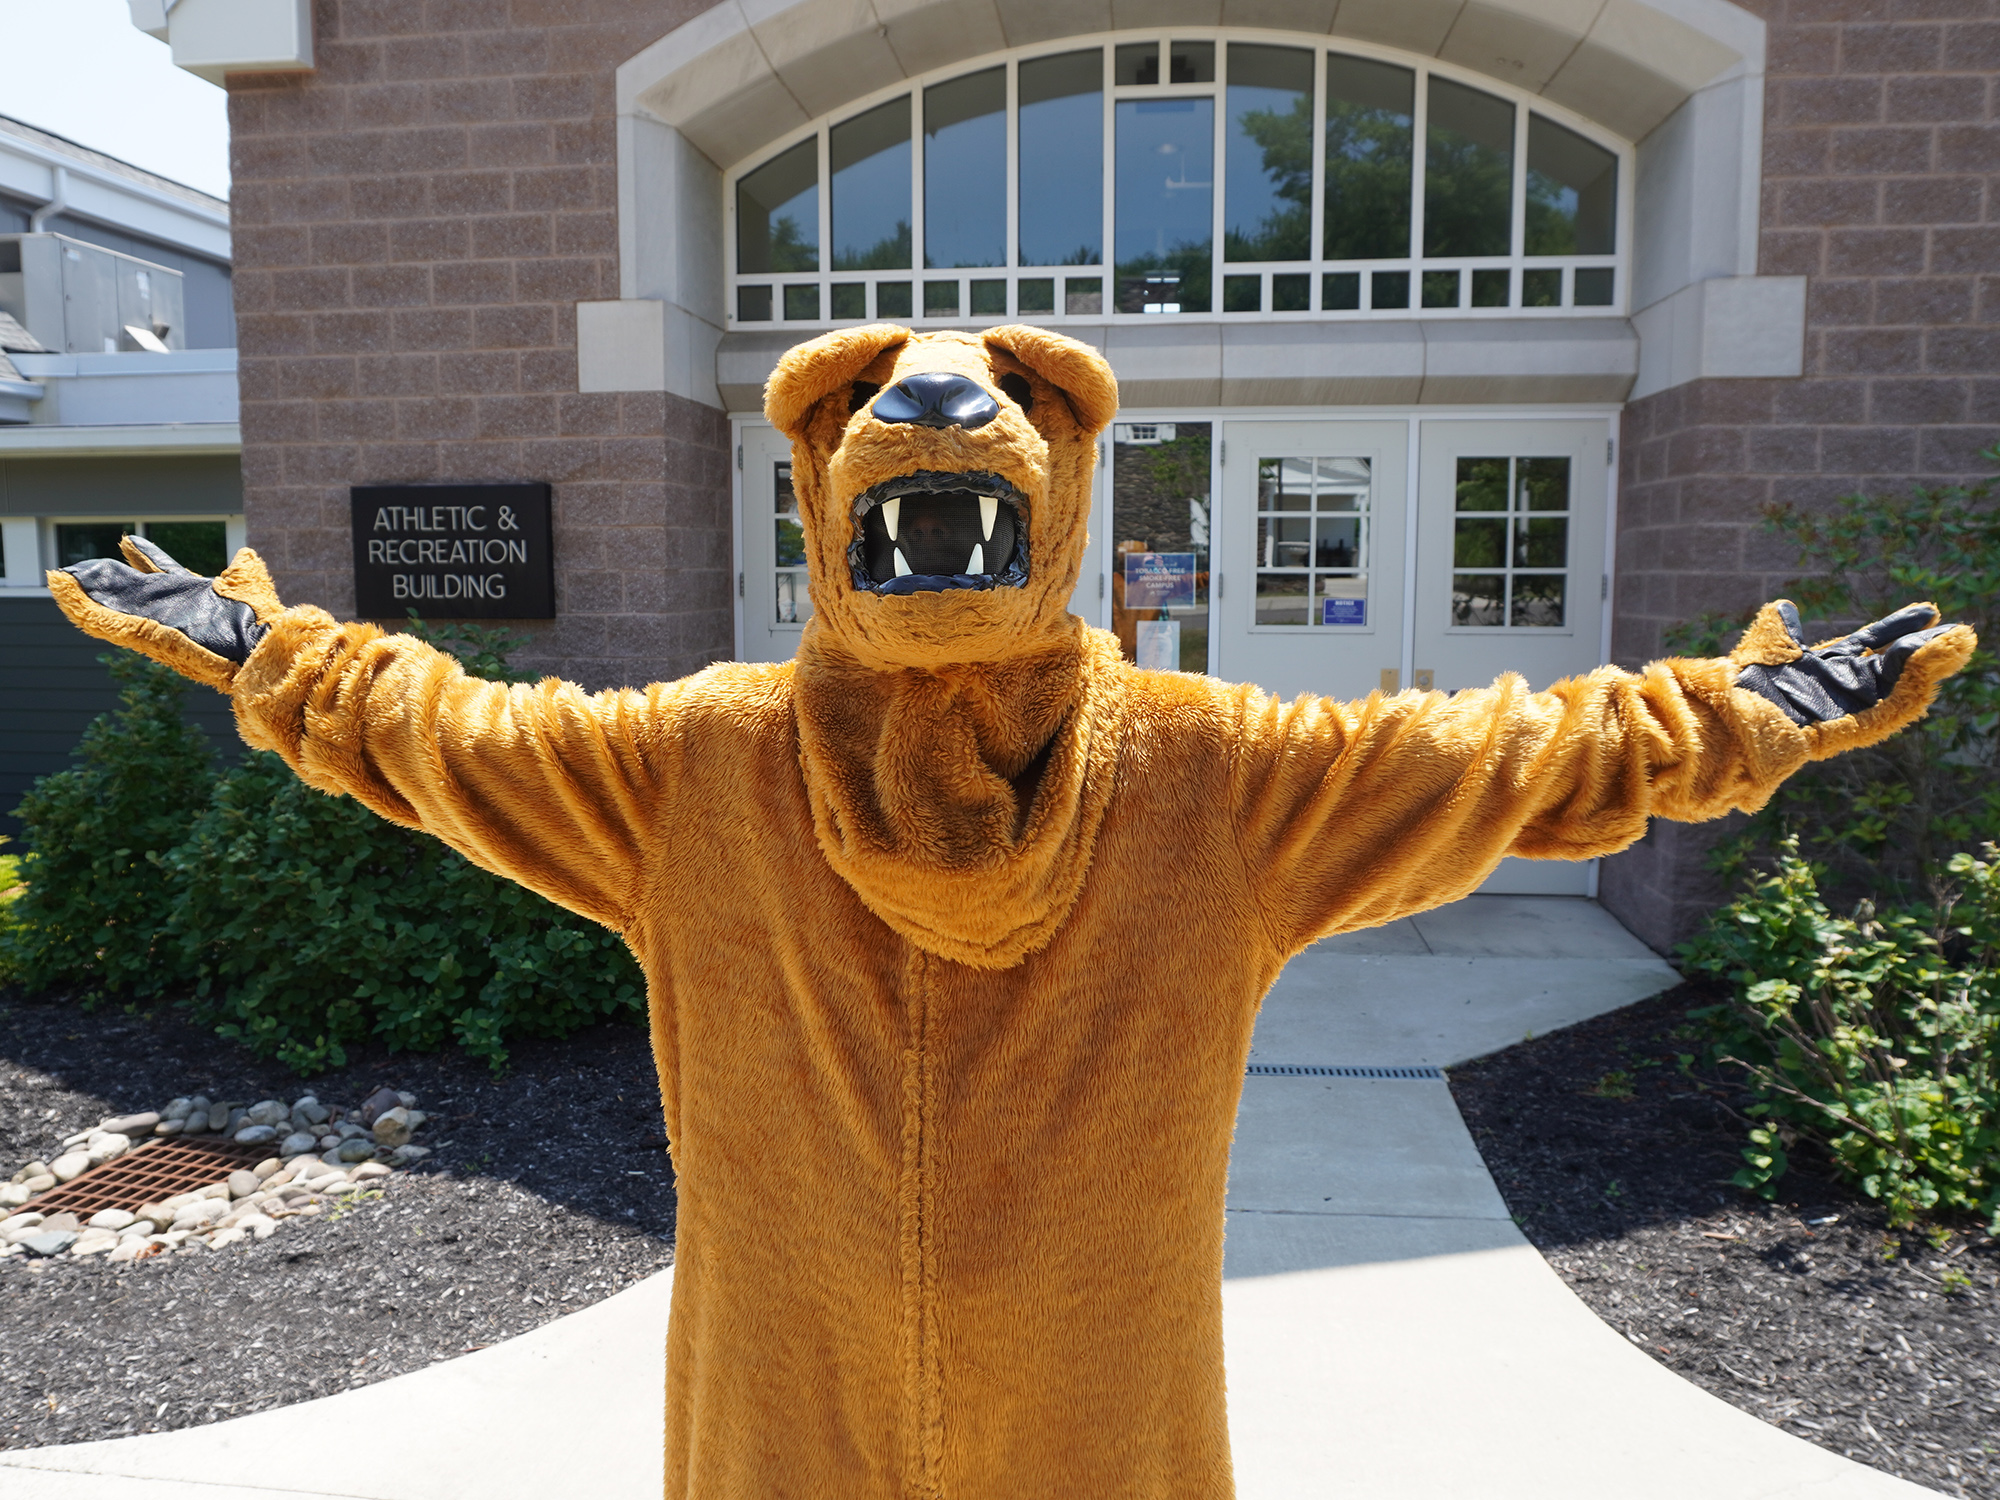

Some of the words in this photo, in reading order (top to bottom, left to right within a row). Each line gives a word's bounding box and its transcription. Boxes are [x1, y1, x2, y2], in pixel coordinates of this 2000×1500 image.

[373, 505, 487, 531] ATHLETIC
[497, 505, 520, 531] &
[368, 538, 528, 564] RECREATION
[392, 573, 506, 599] BUILDING
